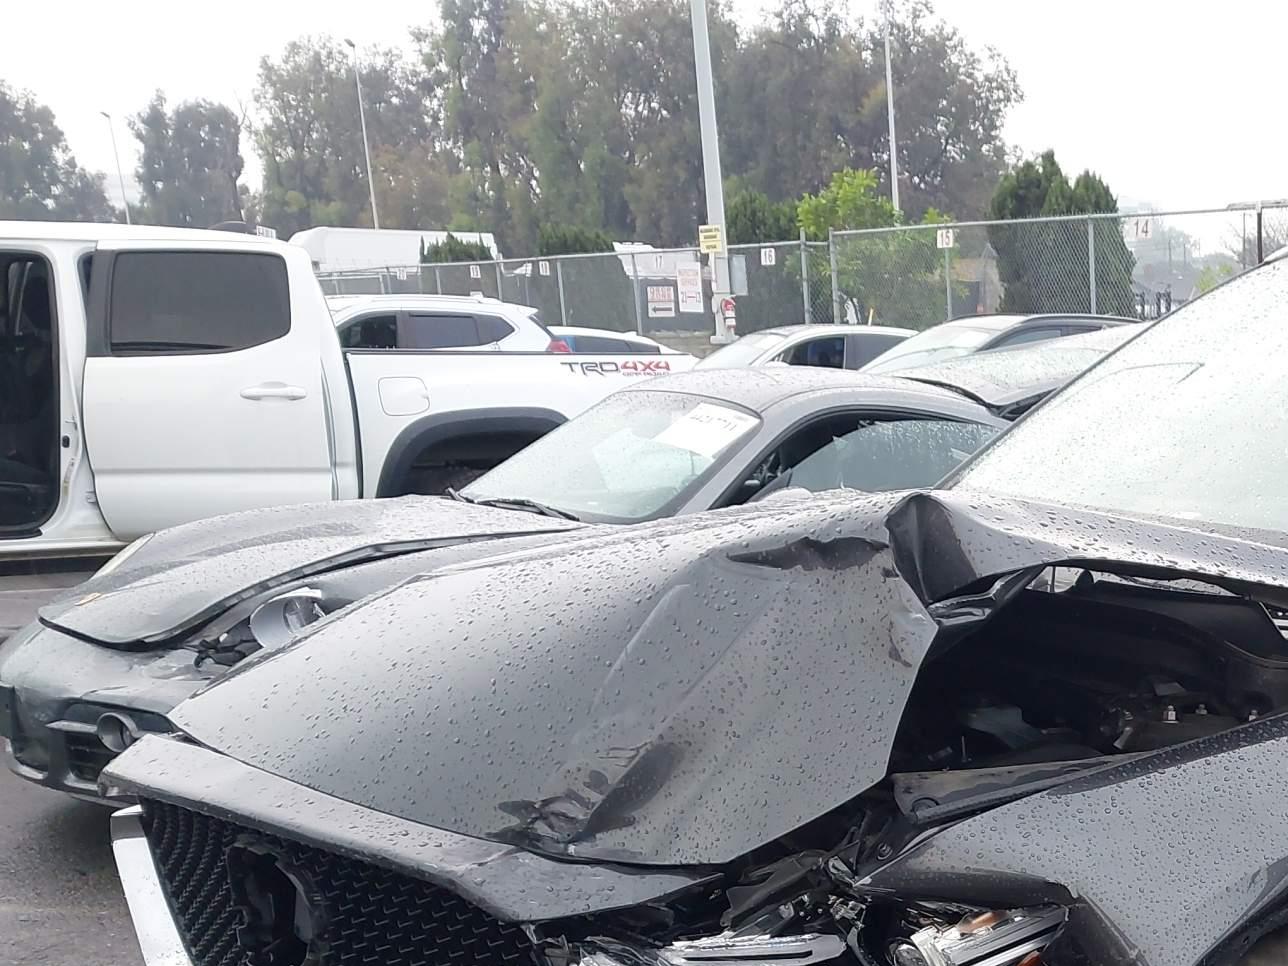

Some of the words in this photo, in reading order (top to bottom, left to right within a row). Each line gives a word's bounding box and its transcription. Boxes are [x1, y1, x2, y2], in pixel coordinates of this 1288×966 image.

[1134, 219, 1149, 237] 14
[764, 249, 774, 263] 16
[560, 362, 619, 376] TRD
